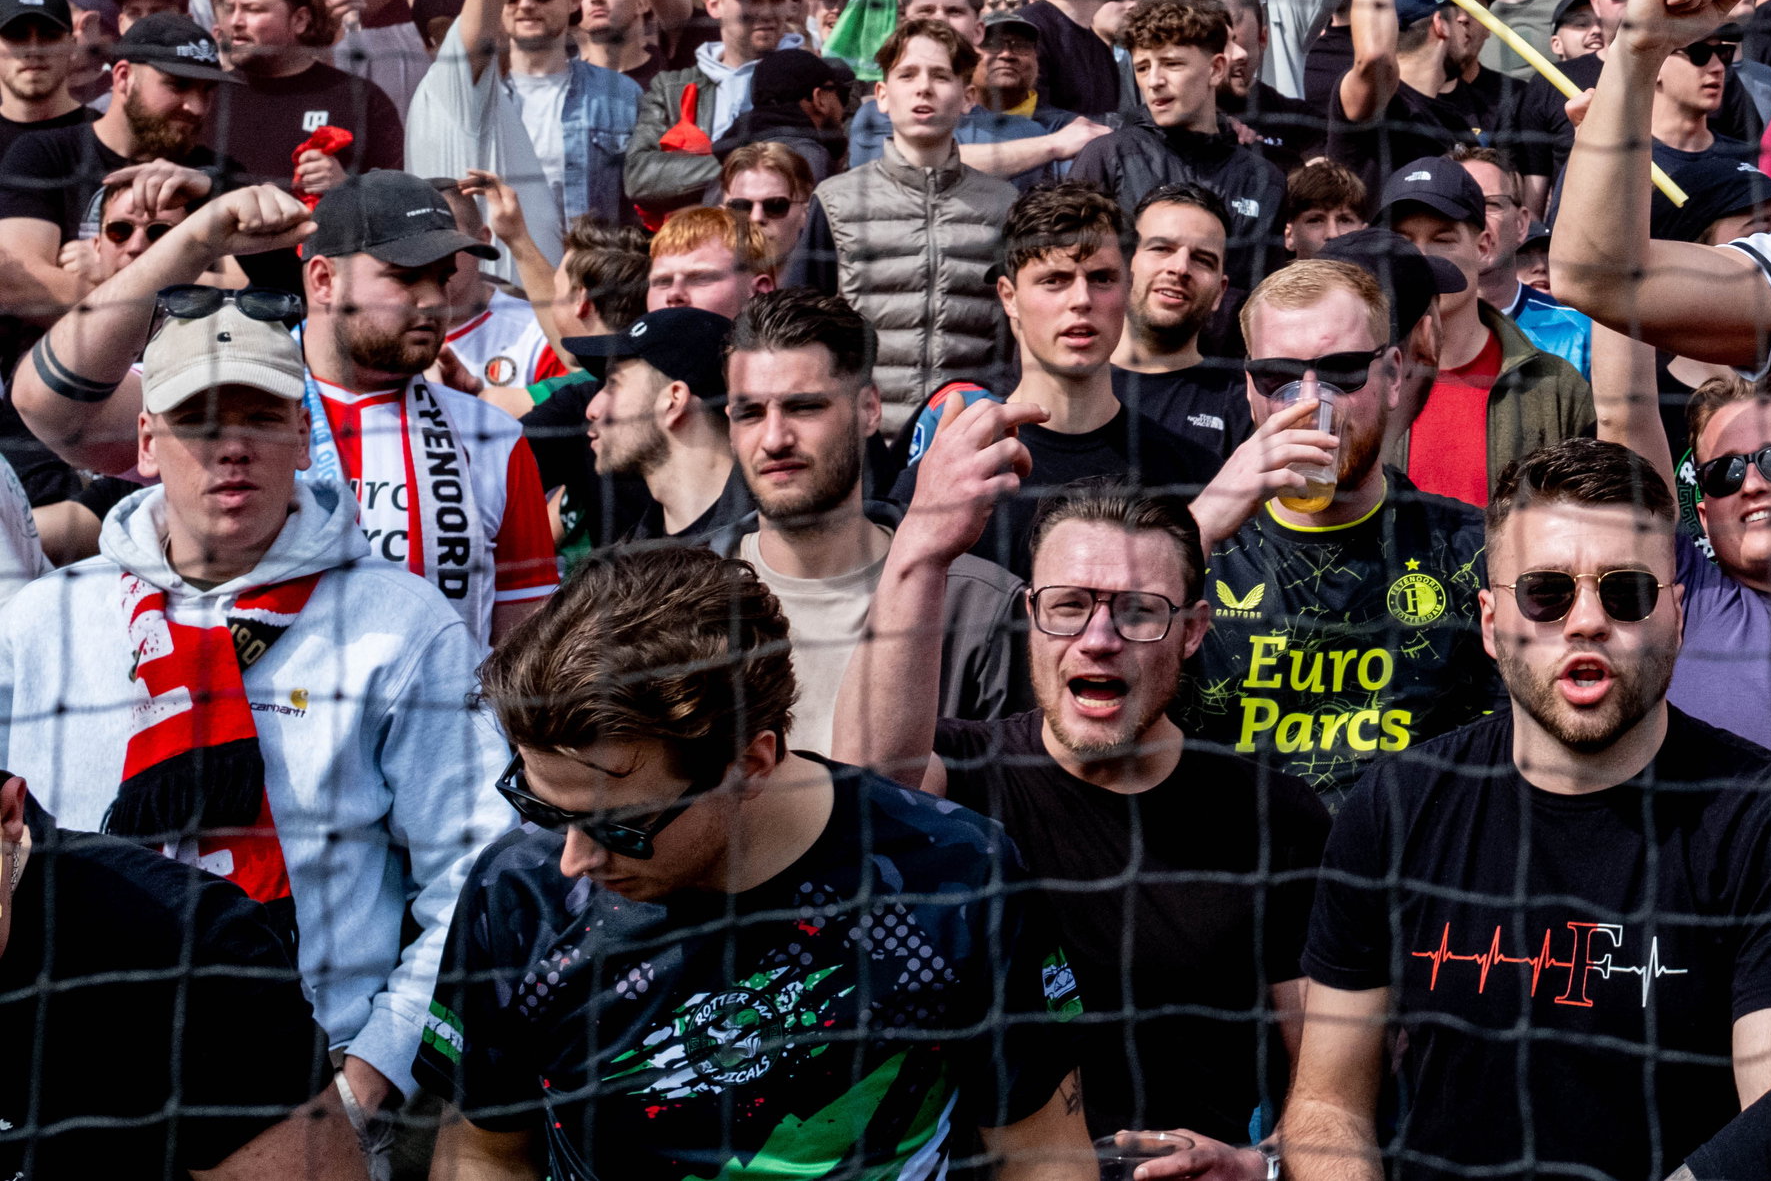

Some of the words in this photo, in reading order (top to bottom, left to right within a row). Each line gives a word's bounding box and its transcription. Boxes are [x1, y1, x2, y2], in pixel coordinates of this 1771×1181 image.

[1242, 635, 1394, 694] Euro
[249, 701, 307, 719] carhartt
[1235, 697, 1413, 754] Parcs
